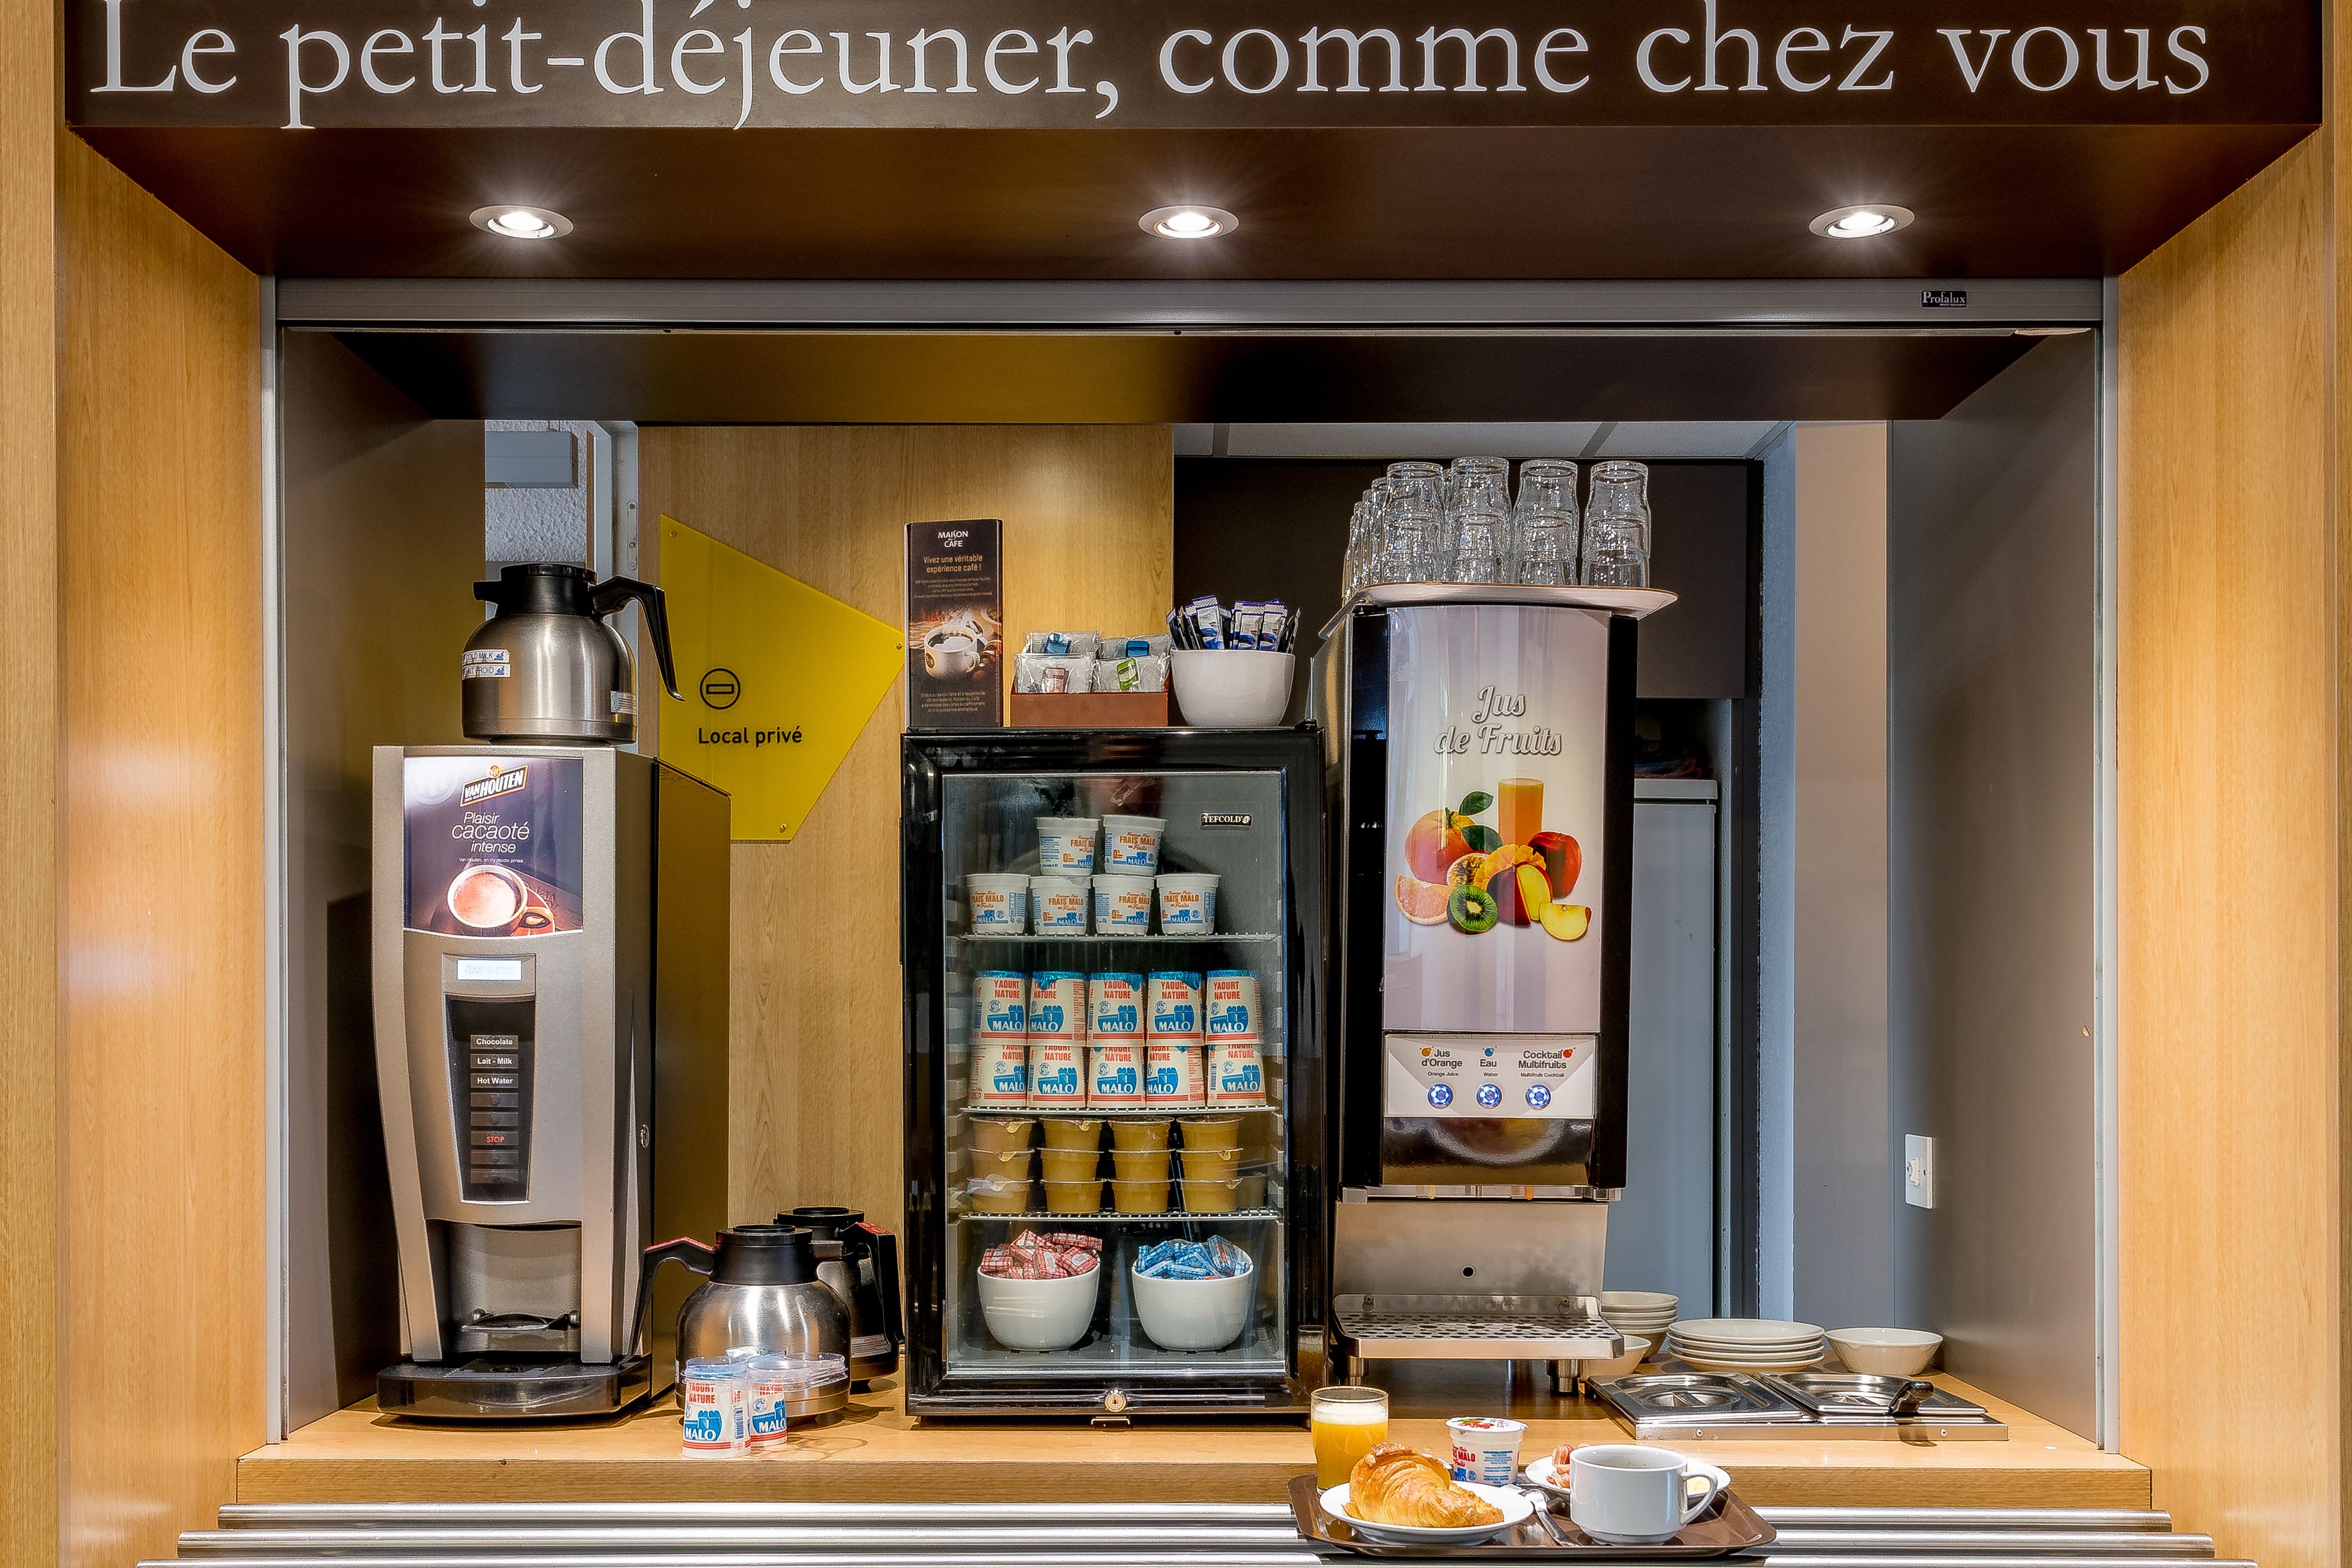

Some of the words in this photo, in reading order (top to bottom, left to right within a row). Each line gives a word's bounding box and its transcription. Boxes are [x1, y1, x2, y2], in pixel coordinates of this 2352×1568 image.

[90, 0, 237, 94] Le
[280, 0, 1119, 129] petit-déjeuner,
[1159, 26, 1589, 94] comme
[1635, 0, 1893, 93] chez
[1937, 25, 2209, 94] vous
[1923, 292, 1966, 303] Profalux
[938, 530, 968, 540] MAISON
[926, 565, 962, 574] expérience
[1472, 685, 1526, 723] Jus
[699, 727, 749, 744] Local
[756, 726, 802, 748] privé
[1434, 726, 1471, 754] de
[1478, 723, 1562, 755] Fruits
[464, 812, 500, 824] Plaisir
[451, 821, 530, 840] cacaoté
[470, 841, 516, 853] intense
[994, 980, 1019, 989] YAOURT
[1033, 981, 1057, 990] YART
[1213, 981, 1240, 990] YAOURT
[995, 990, 1020, 998] NATURE
[1033, 990, 1057, 999] NATURE
[1161, 991, 1189, 1000] NATURE
[1214, 991, 1241, 1000] NATURE
[992, 1021, 1022, 1031] MALO
[1031, 1022, 1058, 1032] MALO
[1102, 1022, 1134, 1031] MALO
[1159, 1022, 1191, 1031] MALO
[1213, 1022, 1245, 1033] MALO
[1002, 1052, 1023, 1060] NATURE
[1105, 1054, 1132, 1062] NATURE
[1149, 1053, 1170, 1061] NATURE
[1523, 1050, 1562, 1059] Cocktail
[1422, 1058, 1463, 1069] d'Orange
[1518, 1060, 1567, 1069] Multifruits
[999, 1082, 1025, 1091] MALO
[1042, 1083, 1074, 1094] MALO
[1101, 1084, 1133, 1094] MALO
[1148, 1084, 1174, 1095] MALO
[1227, 1081, 1258, 1091] MALO
[689, 1393, 715, 1404] NATURE
[759, 1418, 786, 1433] MALO
[685, 1427, 717, 1441] MALO
[1458, 1452, 1476, 1462] MALO
